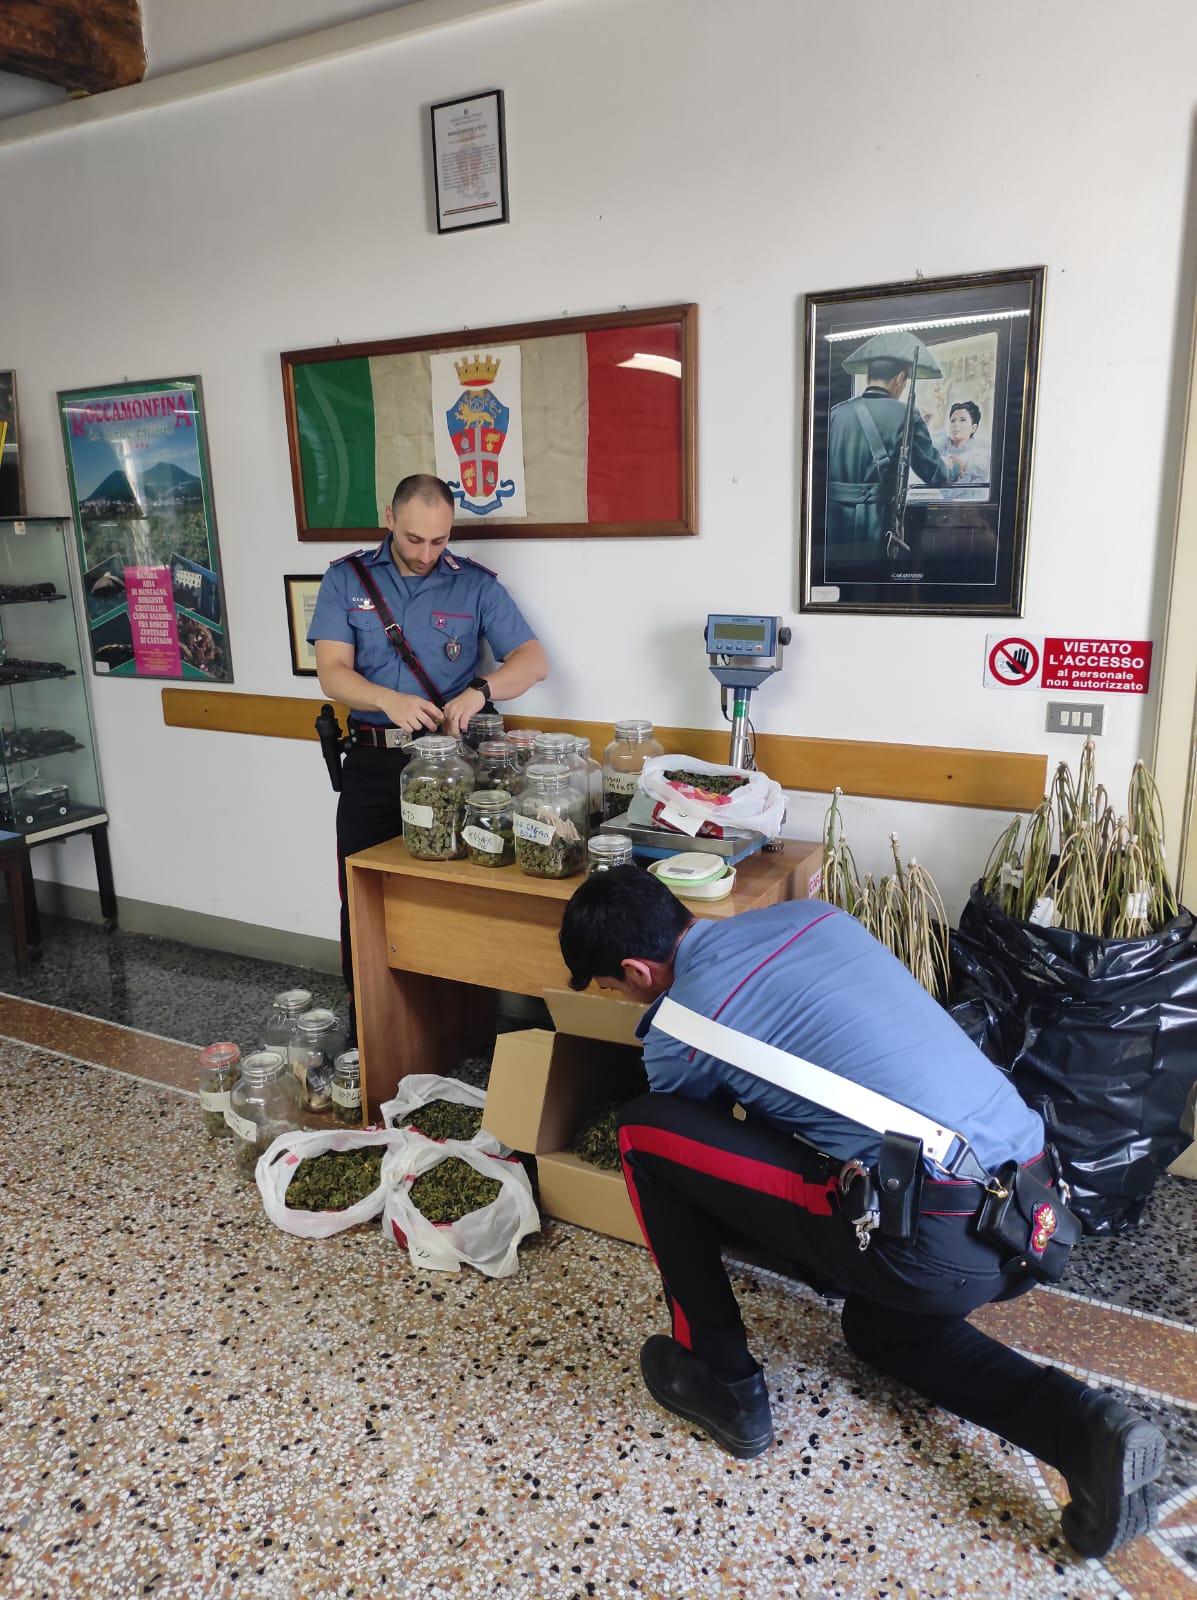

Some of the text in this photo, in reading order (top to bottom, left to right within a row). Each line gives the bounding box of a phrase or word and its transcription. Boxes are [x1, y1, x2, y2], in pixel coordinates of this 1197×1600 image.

[72, 394, 192, 436] ROCCAMONFINA
[1063, 641, 1132, 655] VIETATO
[1049, 654, 1145, 669] L'ACCESSO
[1057, 669, 1134, 680] al personale
[1072, 680, 1144, 691] autorizzato
